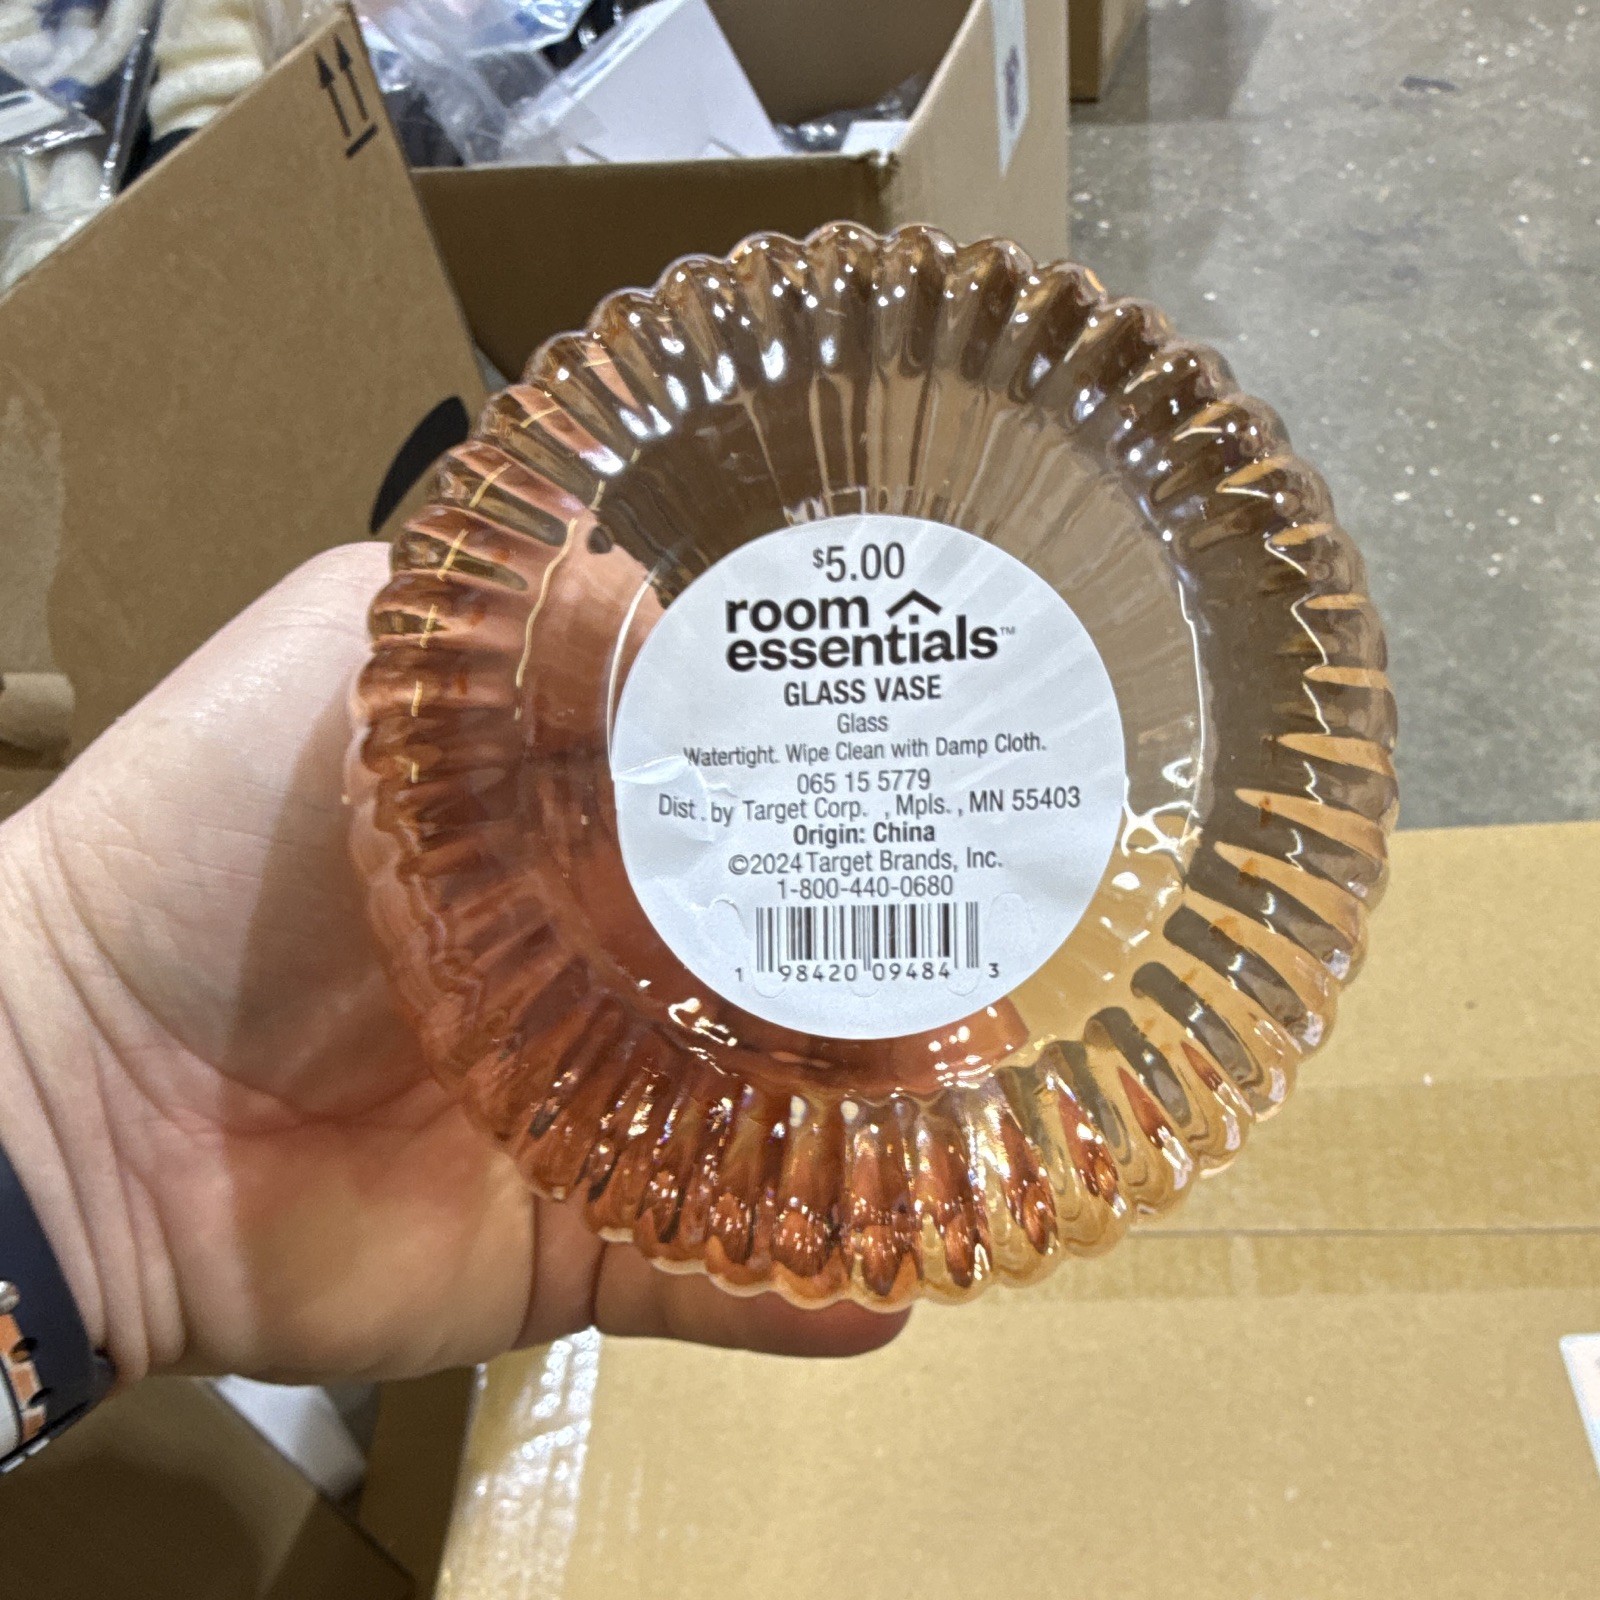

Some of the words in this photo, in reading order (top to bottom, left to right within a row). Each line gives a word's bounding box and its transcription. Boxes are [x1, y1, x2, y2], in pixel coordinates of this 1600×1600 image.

[812, 541, 905, 583] $5.00
[725, 595, 869, 633] room
[725, 614, 999, 672] essentials
[783, 679, 866, 707] GLASS
[874, 674, 942, 702] VASE
[836, 712, 889, 734] Glass
[683, 745, 780, 768] Watertight.
[785, 743, 829, 766] Wipe
[835, 740, 885, 762] Clean
[890, 738, 929, 758] with
[935, 735, 988, 758] Damp
[994, 731, 1047, 753] Cloth.
[797, 772, 837, 795] 065
[844, 770, 871, 794] 15
[877, 767, 931, 792] 5779
[711, 801, 735, 828] by
[742, 798, 808, 825] Target
[969, 789, 1004, 813] MN
[1011, 785, 1081, 812] 55403
[793, 824, 866, 849] Origin:
[873, 820, 936, 844] China
[805, 850, 874, 877] Target
[879, 847, 959, 873] Brands,
[966, 846, 1003, 869] Inc.
[777, 874, 954, 900] 1-800-440-0680
[778, 964, 858, 983] 98420
[872, 961, 951, 982] 09484
[987, 962, 1000, 979] 3
